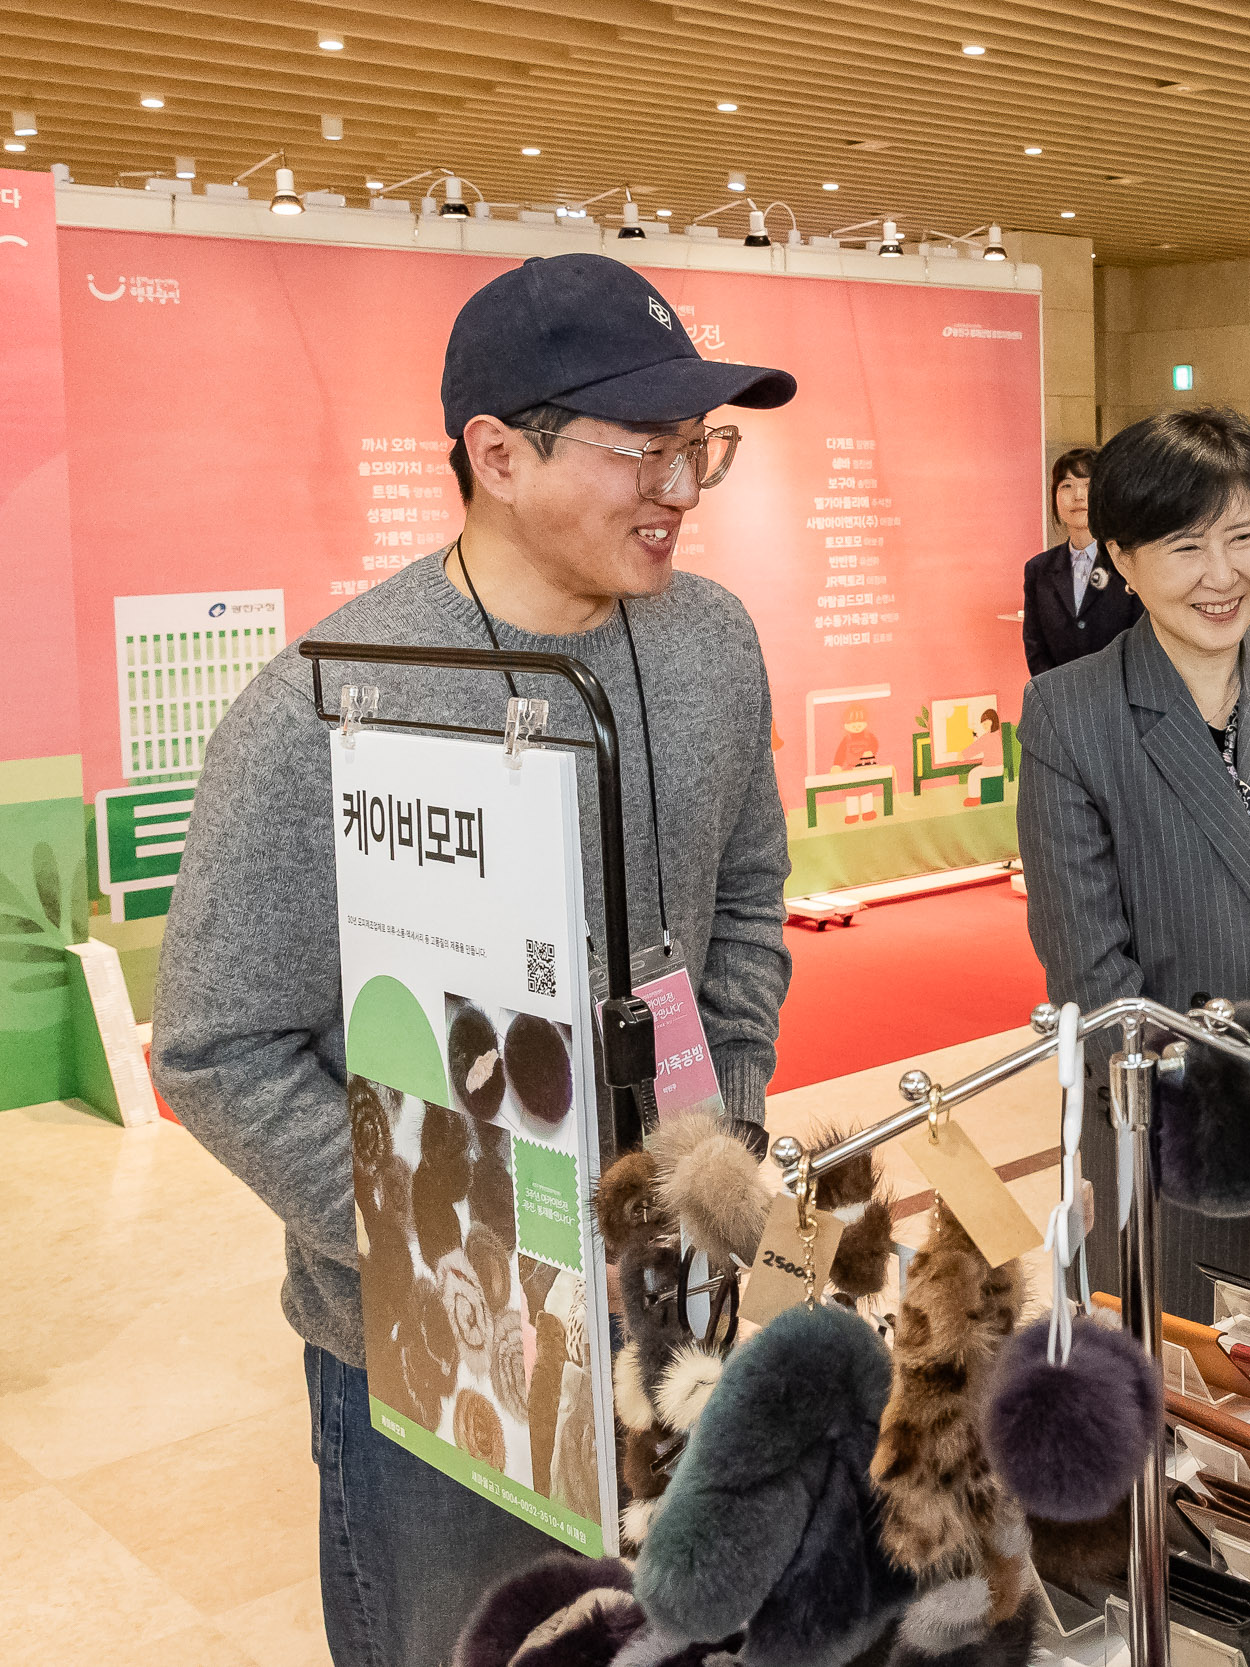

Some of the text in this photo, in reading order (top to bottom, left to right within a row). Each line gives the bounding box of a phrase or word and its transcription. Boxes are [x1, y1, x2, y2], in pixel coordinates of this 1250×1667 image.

[0, 188, 22, 208] 다
[362, 438, 388, 451] 까사
[391, 438, 416, 451] 오하
[828, 478, 855, 489] 보구아
[367, 508, 418, 523] 성광패션
[362, 553, 425, 570] 컬러즈누
[829, 555, 858, 568] 반반한
[814, 612, 878, 628] 성수동가죽공방
[824, 632, 870, 647] 케이비모피
[343, 790, 485, 878] 케이비모피
[654, 1043, 704, 1081] 가죽공방
